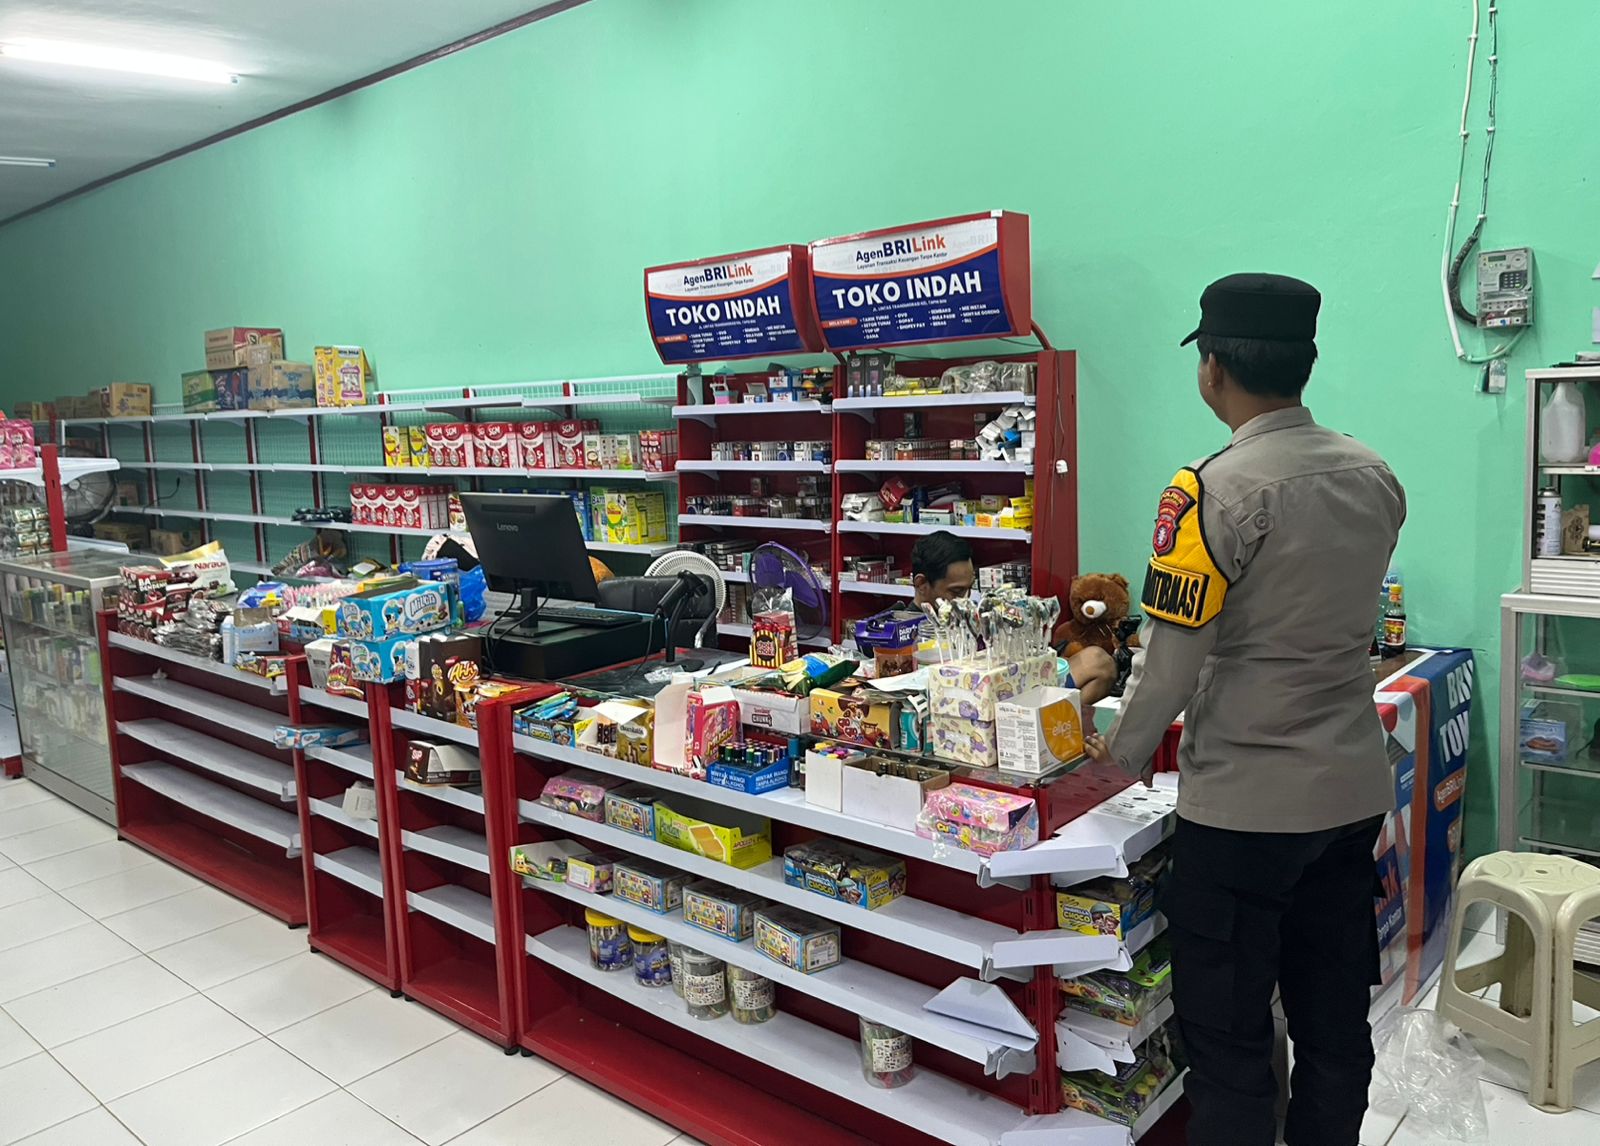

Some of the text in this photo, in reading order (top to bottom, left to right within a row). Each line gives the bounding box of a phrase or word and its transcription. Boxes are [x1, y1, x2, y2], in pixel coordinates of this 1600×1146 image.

[856, 234, 946, 263] AgenBRILink
[684, 263, 753, 287] AgenBRILink
[832, 270, 982, 309] TOKO INDAH
[666, 303, 721, 327] TOKO
[724, 296, 781, 320] INDAH
[489, 425, 501, 436] SGM
[523, 424, 536, 435] SGM
[562, 423, 575, 434] SGM
[808, 879, 836, 896] CHOCO
[1064, 911, 1091, 923] CHOCO
